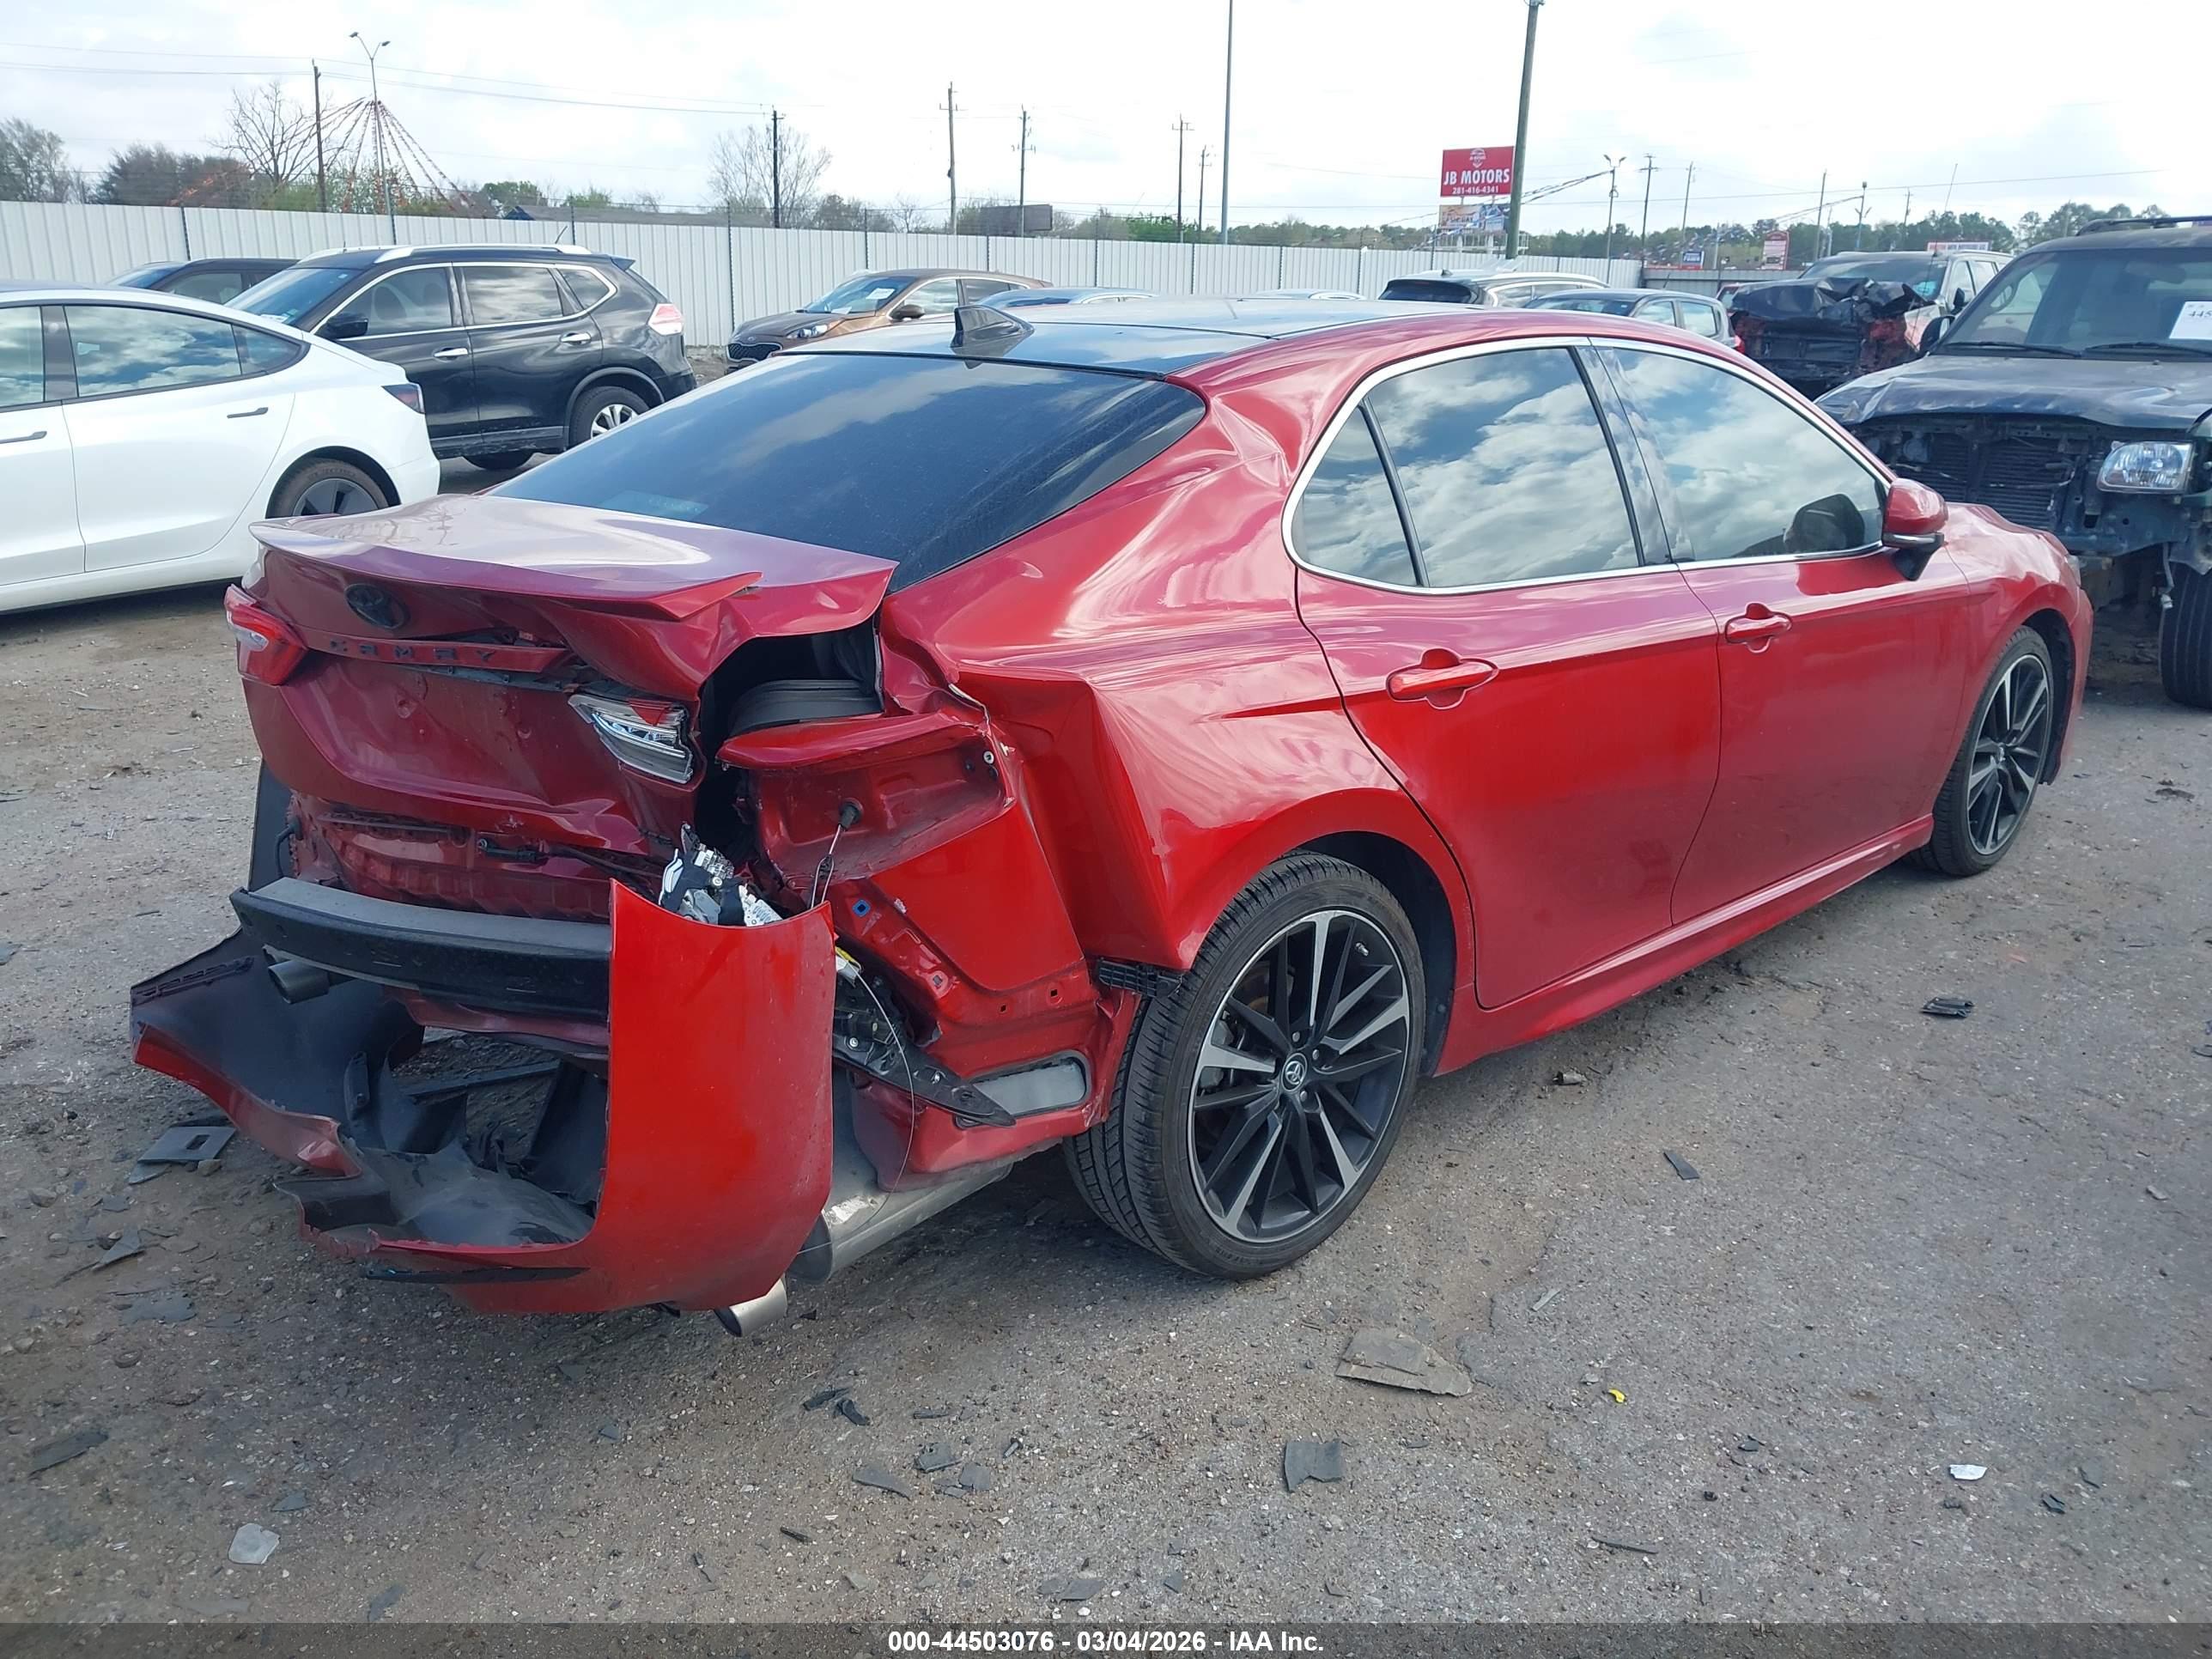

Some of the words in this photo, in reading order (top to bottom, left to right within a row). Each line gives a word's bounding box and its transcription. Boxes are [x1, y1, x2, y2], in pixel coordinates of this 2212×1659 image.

[1443, 171, 1457, 185] JB
[1461, 168, 1510, 185] MOTORS
[1452, 185, 1498, 195] 281-416-4341
